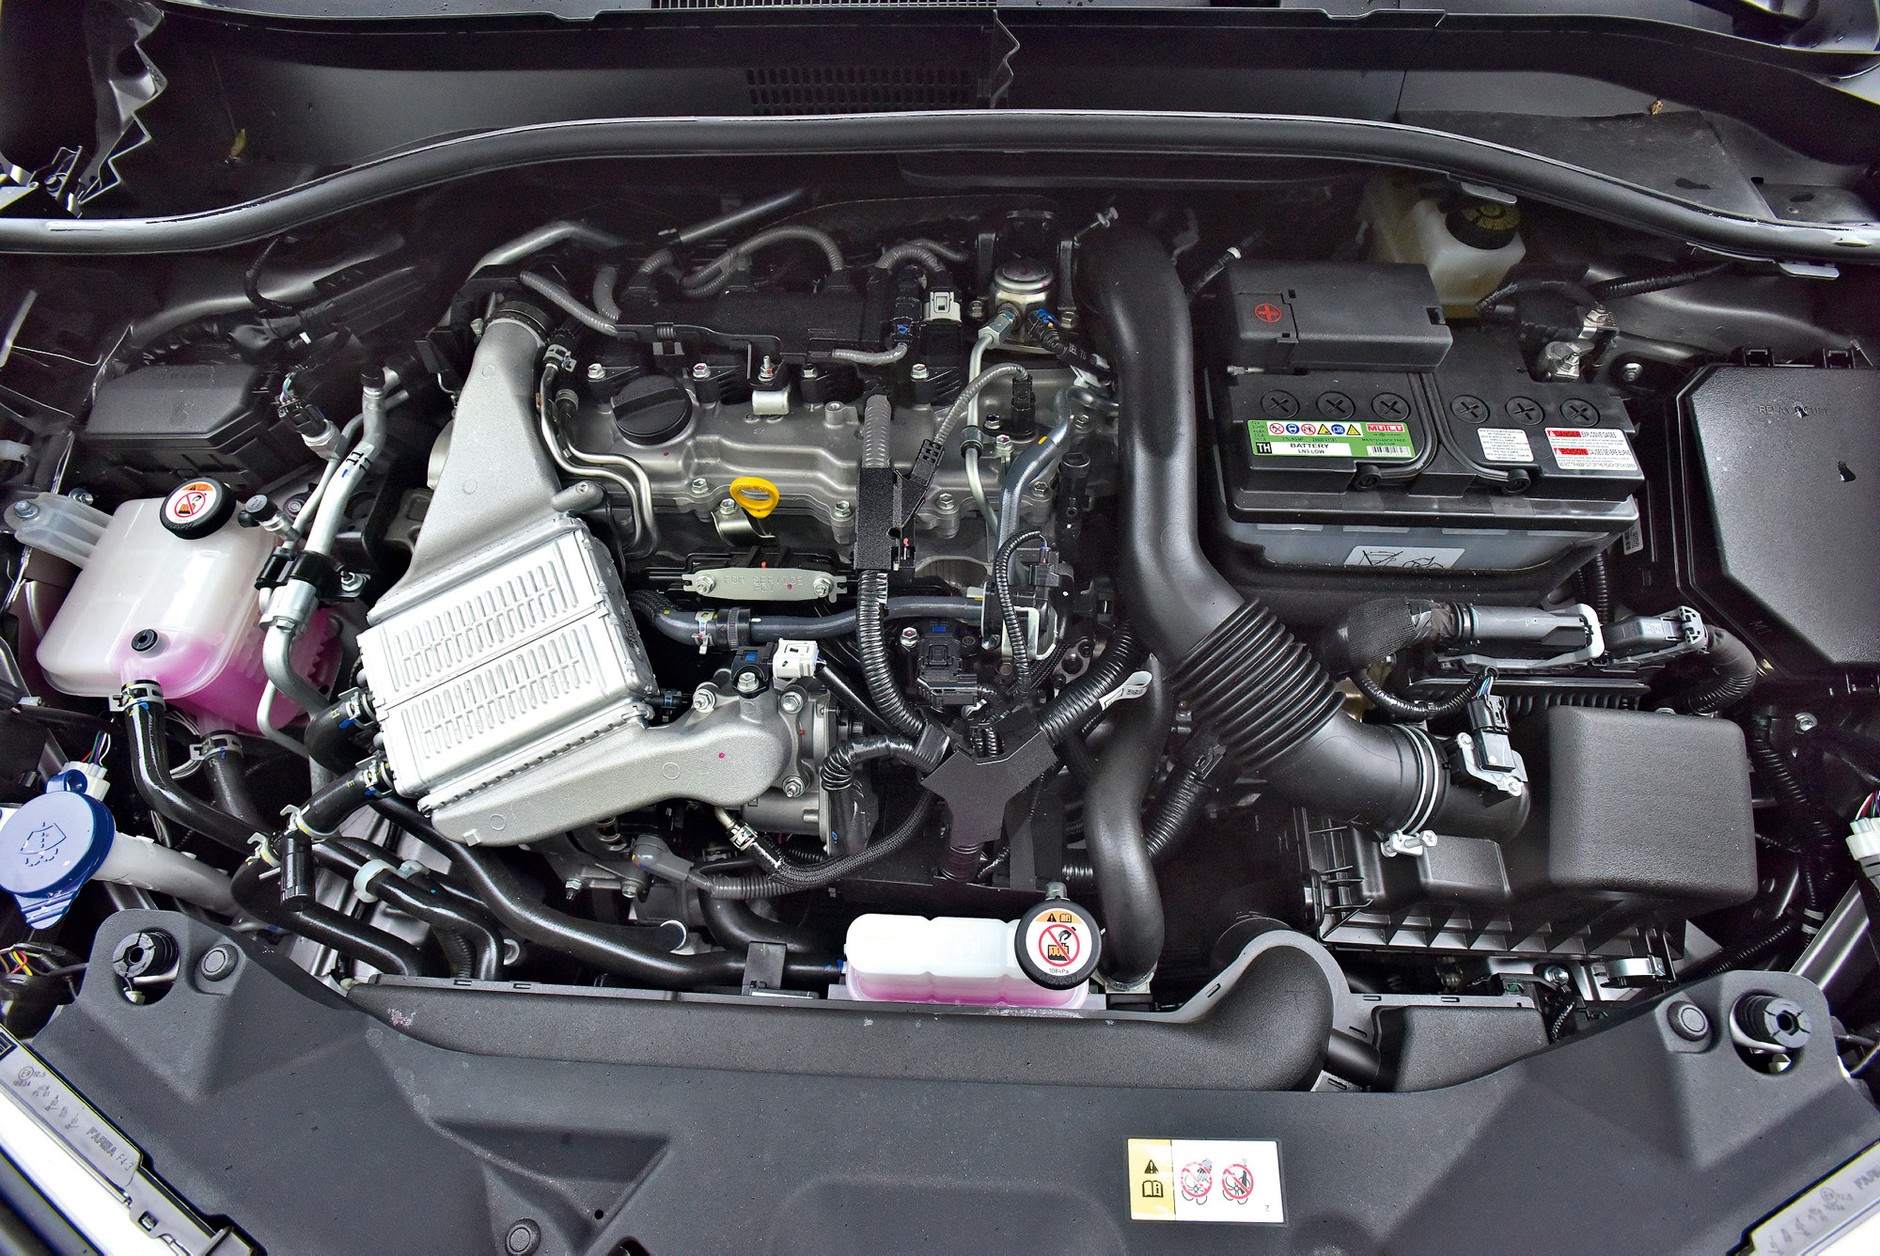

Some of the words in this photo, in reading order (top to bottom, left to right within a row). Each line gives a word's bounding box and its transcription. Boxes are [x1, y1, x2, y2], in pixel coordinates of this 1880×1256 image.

[1758, 404, 1791, 415] RELAY
[1367, 423, 1404, 432] MUTLU
[1257, 443, 1271, 453] TH
